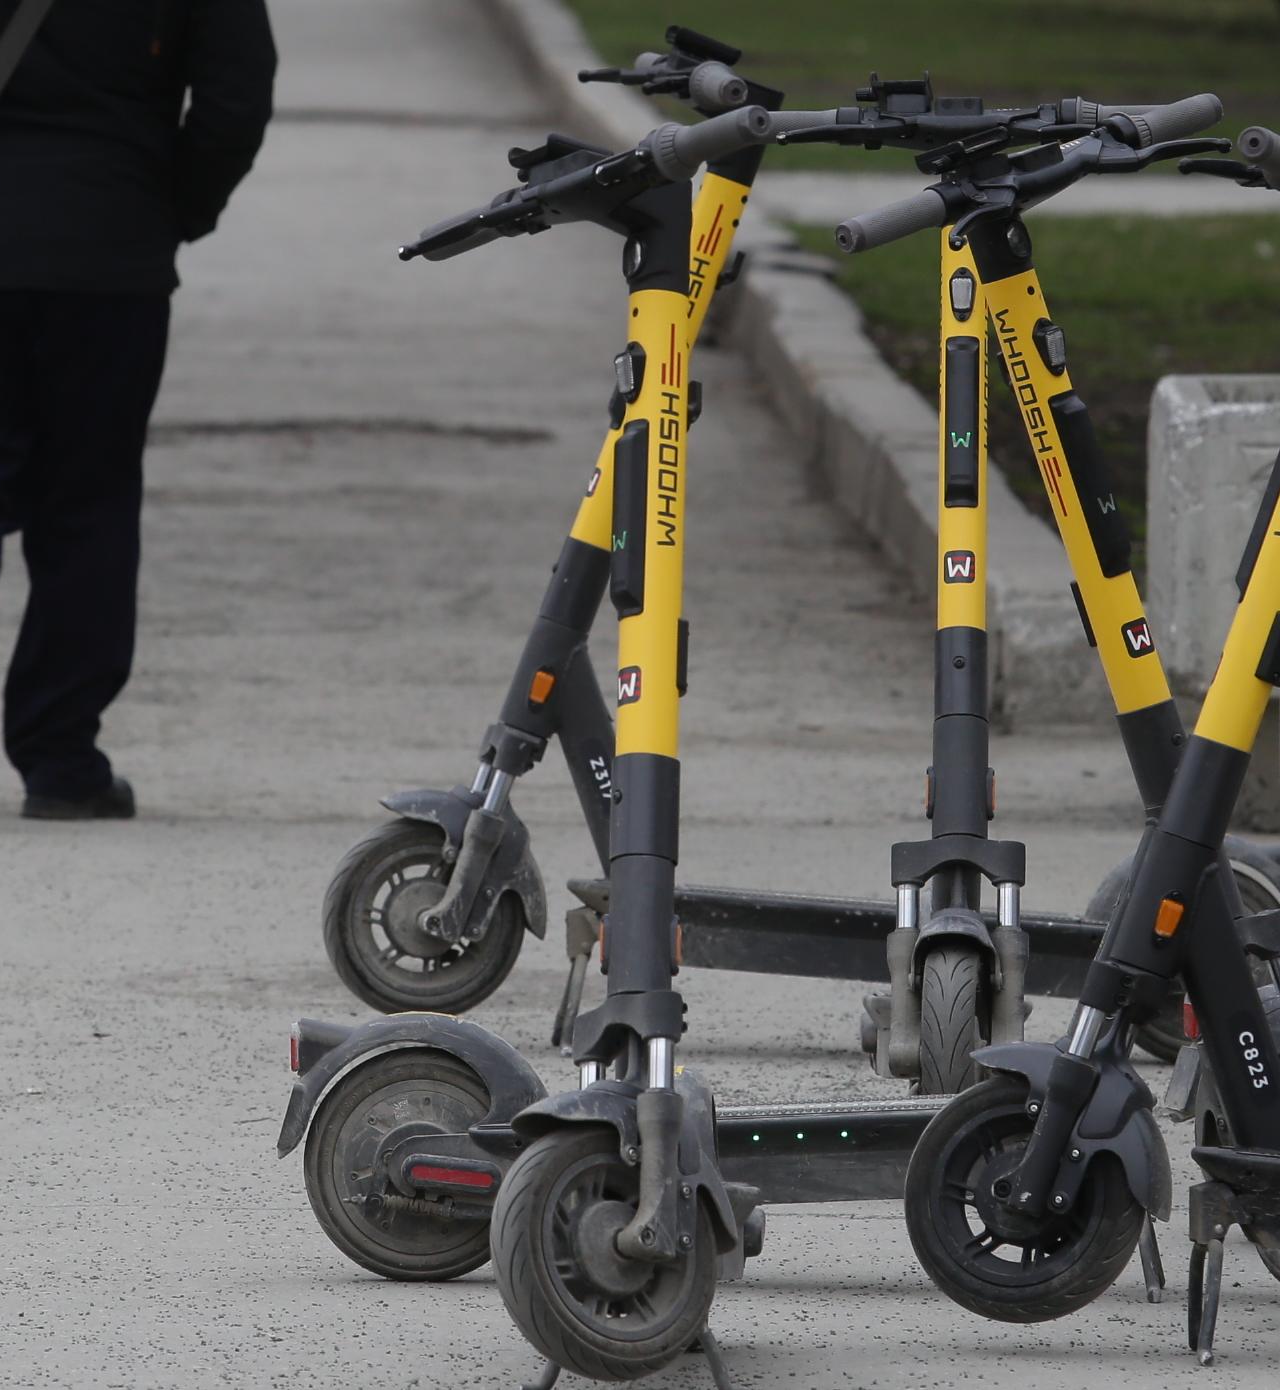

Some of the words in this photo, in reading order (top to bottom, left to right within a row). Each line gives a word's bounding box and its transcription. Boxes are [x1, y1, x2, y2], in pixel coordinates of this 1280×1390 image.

[995, 308, 1053, 453] WHOOSH
[950, 431, 972, 448] W
[656, 391, 680, 547] WHOOSH
[1097, 493, 1116, 515] W
[612, 530, 627, 552] W
[946, 556, 971, 578] W
[1126, 623, 1151, 651] W
[1238, 1031, 1269, 1089] C823
